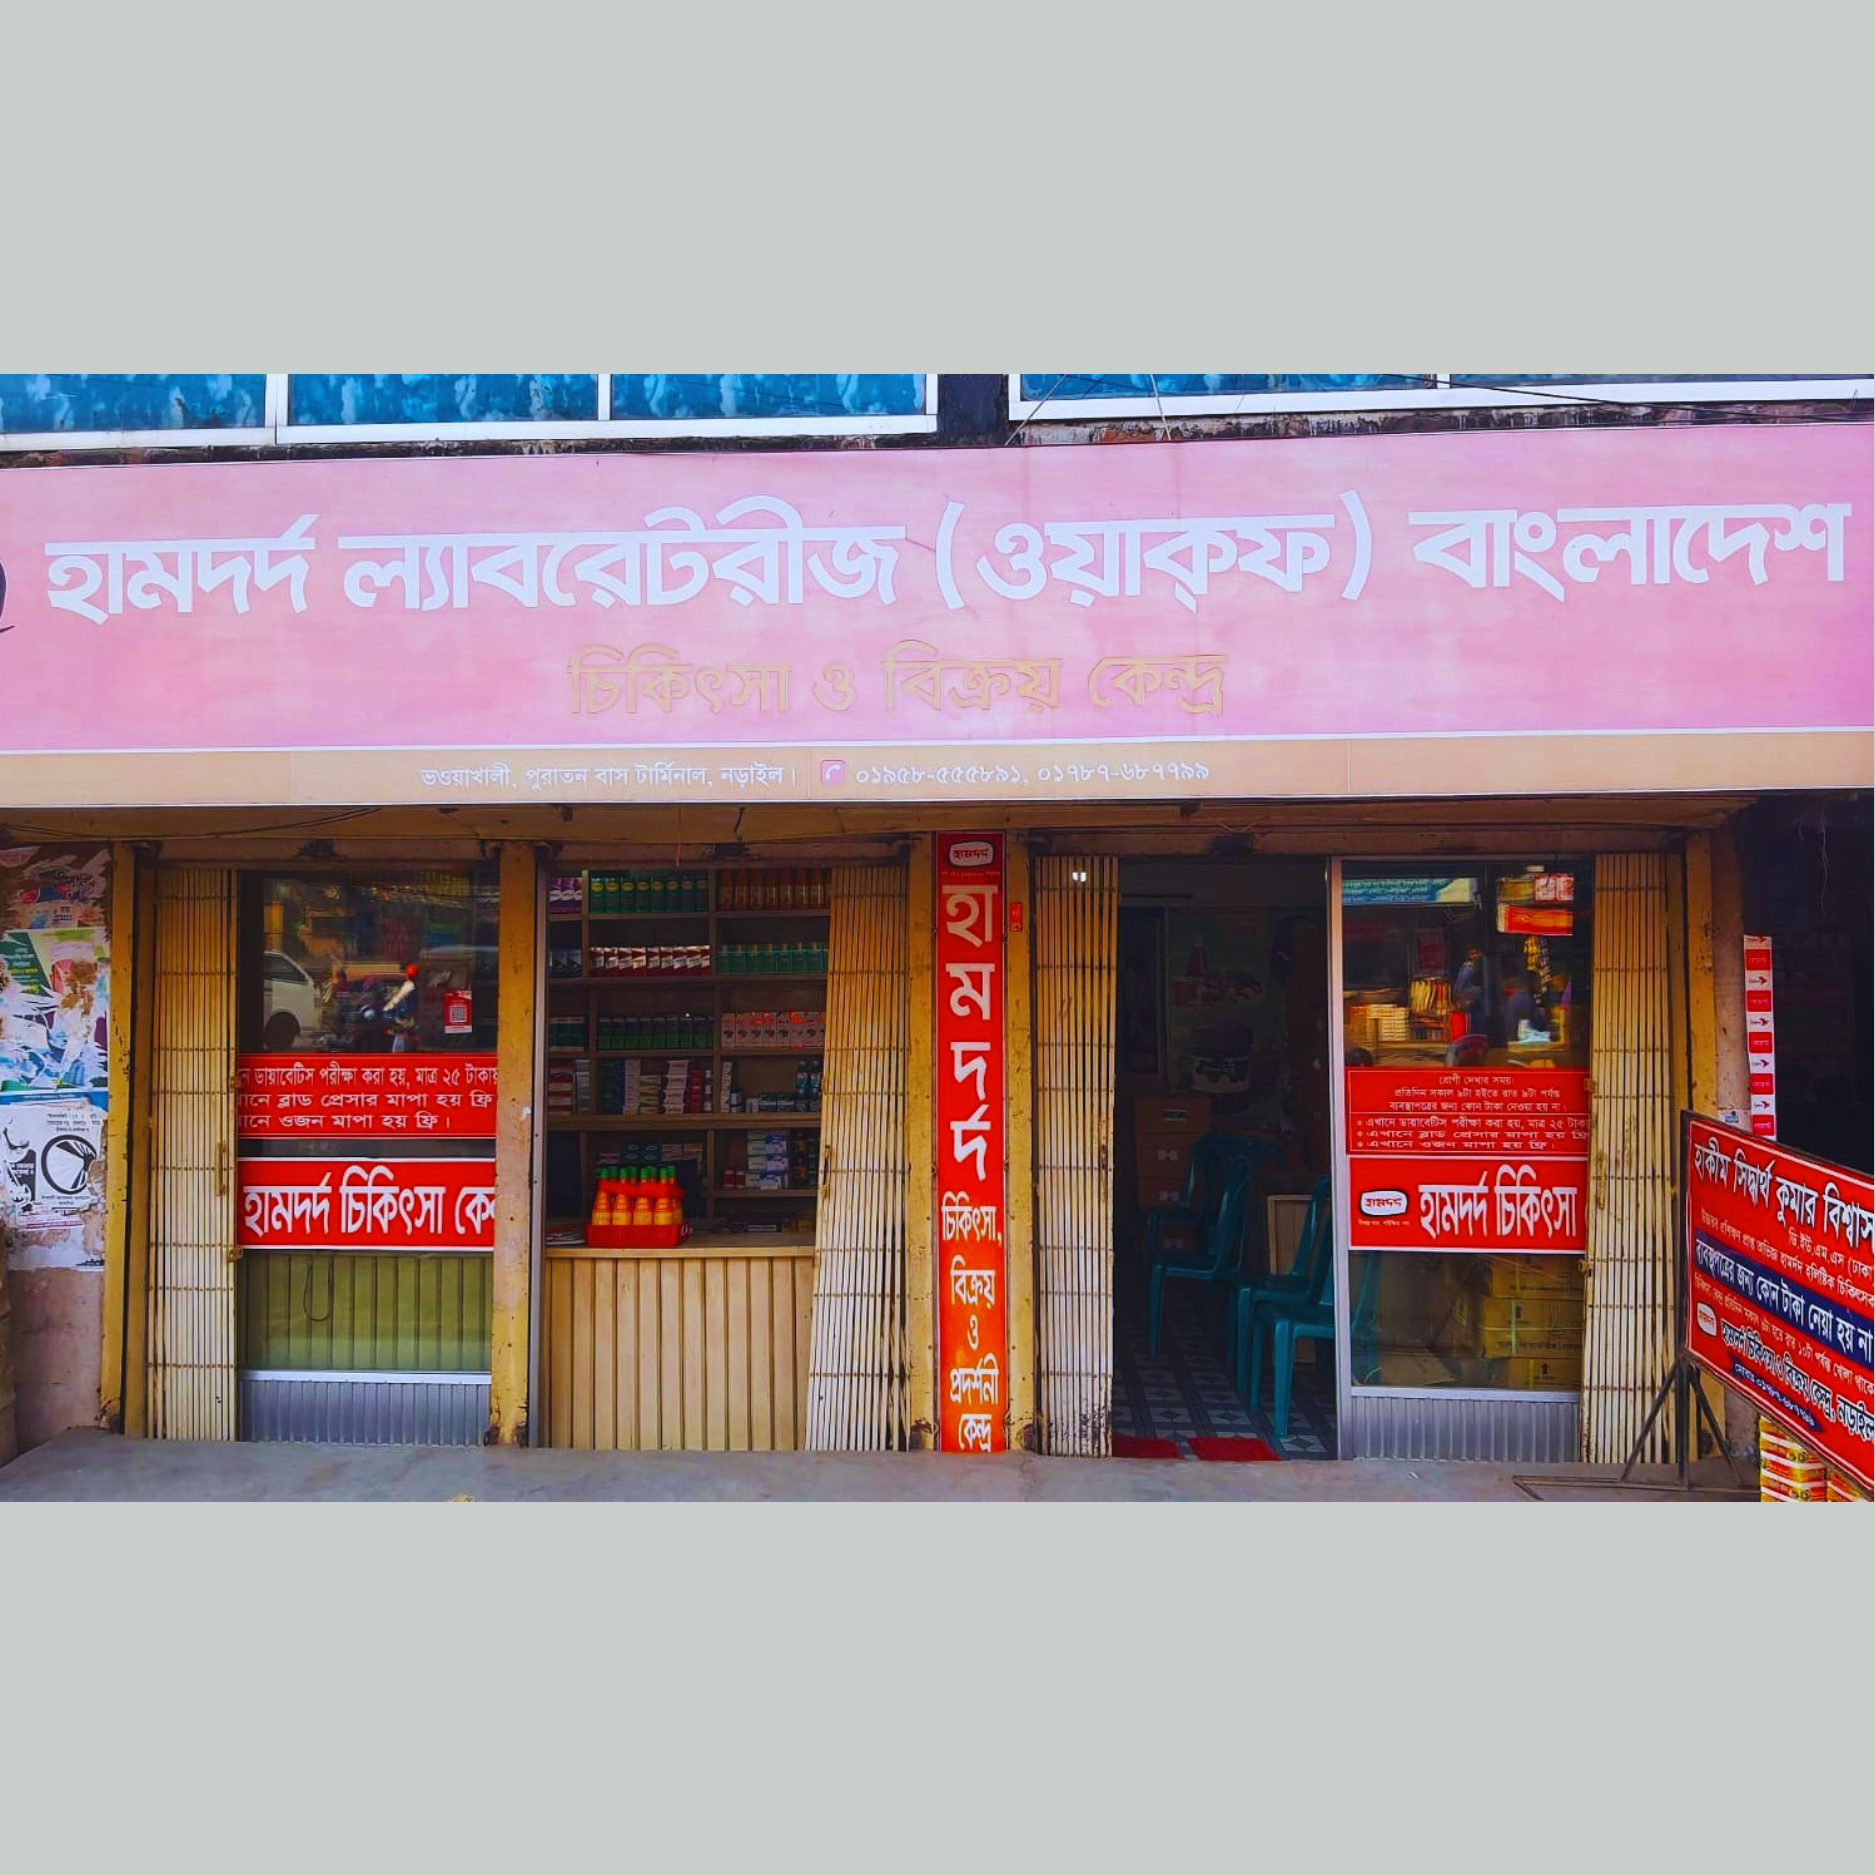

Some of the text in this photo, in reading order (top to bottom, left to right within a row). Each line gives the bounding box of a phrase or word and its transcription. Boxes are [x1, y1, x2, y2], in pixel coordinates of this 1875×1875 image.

[44, 514, 320, 625] হামদর্দ
[338, 496, 906, 612] ল্যাবরেটরীজ
[1408, 502, 1852, 602] বাংলাদেশ
[567, 639, 1228, 718] চিকিৎসা ও বিক্রয় কেন্দ্র
[525, 768, 587, 790] পুরাতন
[595, 769, 628, 786] বাস
[254, 1062, 314, 1086] ডায়াবেটিস
[320, 1061, 357, 1086] পরীক্ষা
[361, 1067, 384, 1085] করা
[415, 1068, 438, 1086] মাত্র
[443, 1069, 460, 1086] ২৫
[1439, 1073, 1460, 1085] রোগী
[277, 1093, 313, 1108] ব্লাড
[321, 1093, 379, 1107] প্রেসার
[387, 1093, 428, 1107] মাপা
[436, 1093, 463, 1107] হয়
[469, 1090, 495, 1108] ফ্রি
[280, 1115, 324, 1128] ওজন
[332, 1115, 375, 1128] মাপা
[381, 1115, 409, 1129] হয়
[1549, 1119, 1563, 1131] ২৫
[244, 1172, 332, 1237] হামদর্দ
[339, 1165, 446, 1235] চিকিৎসা
[1418, 1164, 1578, 1239] হামদর্দ চিকিৎসা
[1694, 1137, 1732, 1190] হাকীম
[1775, 1176, 1819, 1228] কুমার
[950, 1255, 996, 1309] বিক্রয়
[967, 1315, 979, 1350] ও
[1736, 1263, 1754, 1296] জন্য
[1756, 1276, 1780, 1311] কোন
[1780, 1278, 1805, 1326] টাকা
[1809, 1303, 1834, 1342] নেয়া
[1835, 1317, 1855, 1353] হয়
[1857, 1328, 1874, 1364] না
[950, 1353, 999, 1405] প্রদর্শনী
[958, 1413, 992, 1453] কেন্দ্র
